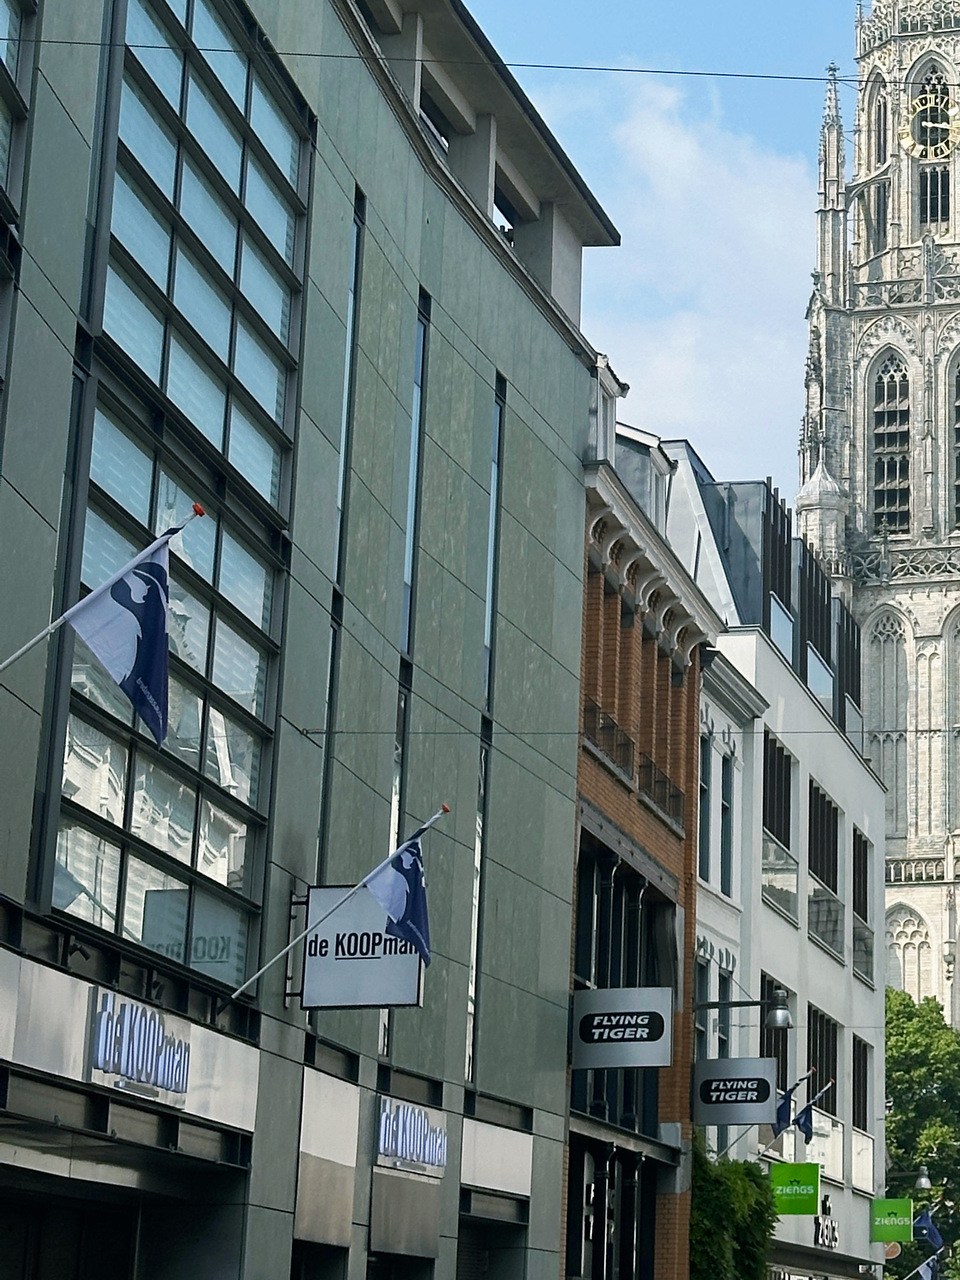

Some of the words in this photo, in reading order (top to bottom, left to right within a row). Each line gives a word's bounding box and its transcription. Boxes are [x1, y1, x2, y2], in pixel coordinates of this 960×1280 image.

[308, 934, 329, 957] de
[335, 932, 418, 959] KOOPman
[593, 1014, 650, 1026] FLYING
[591, 1027, 649, 1039] TIGER
[94, 992, 121, 1076] de
[119, 1003, 190, 1094] KOOPman
[711, 1080, 758, 1090] FLYING
[709, 1091, 758, 1102] TIGER
[379, 1097, 397, 1154] de
[775, 1185, 815, 1194] ZIENGS
[874, 1217, 911, 1225] ZIENGS
